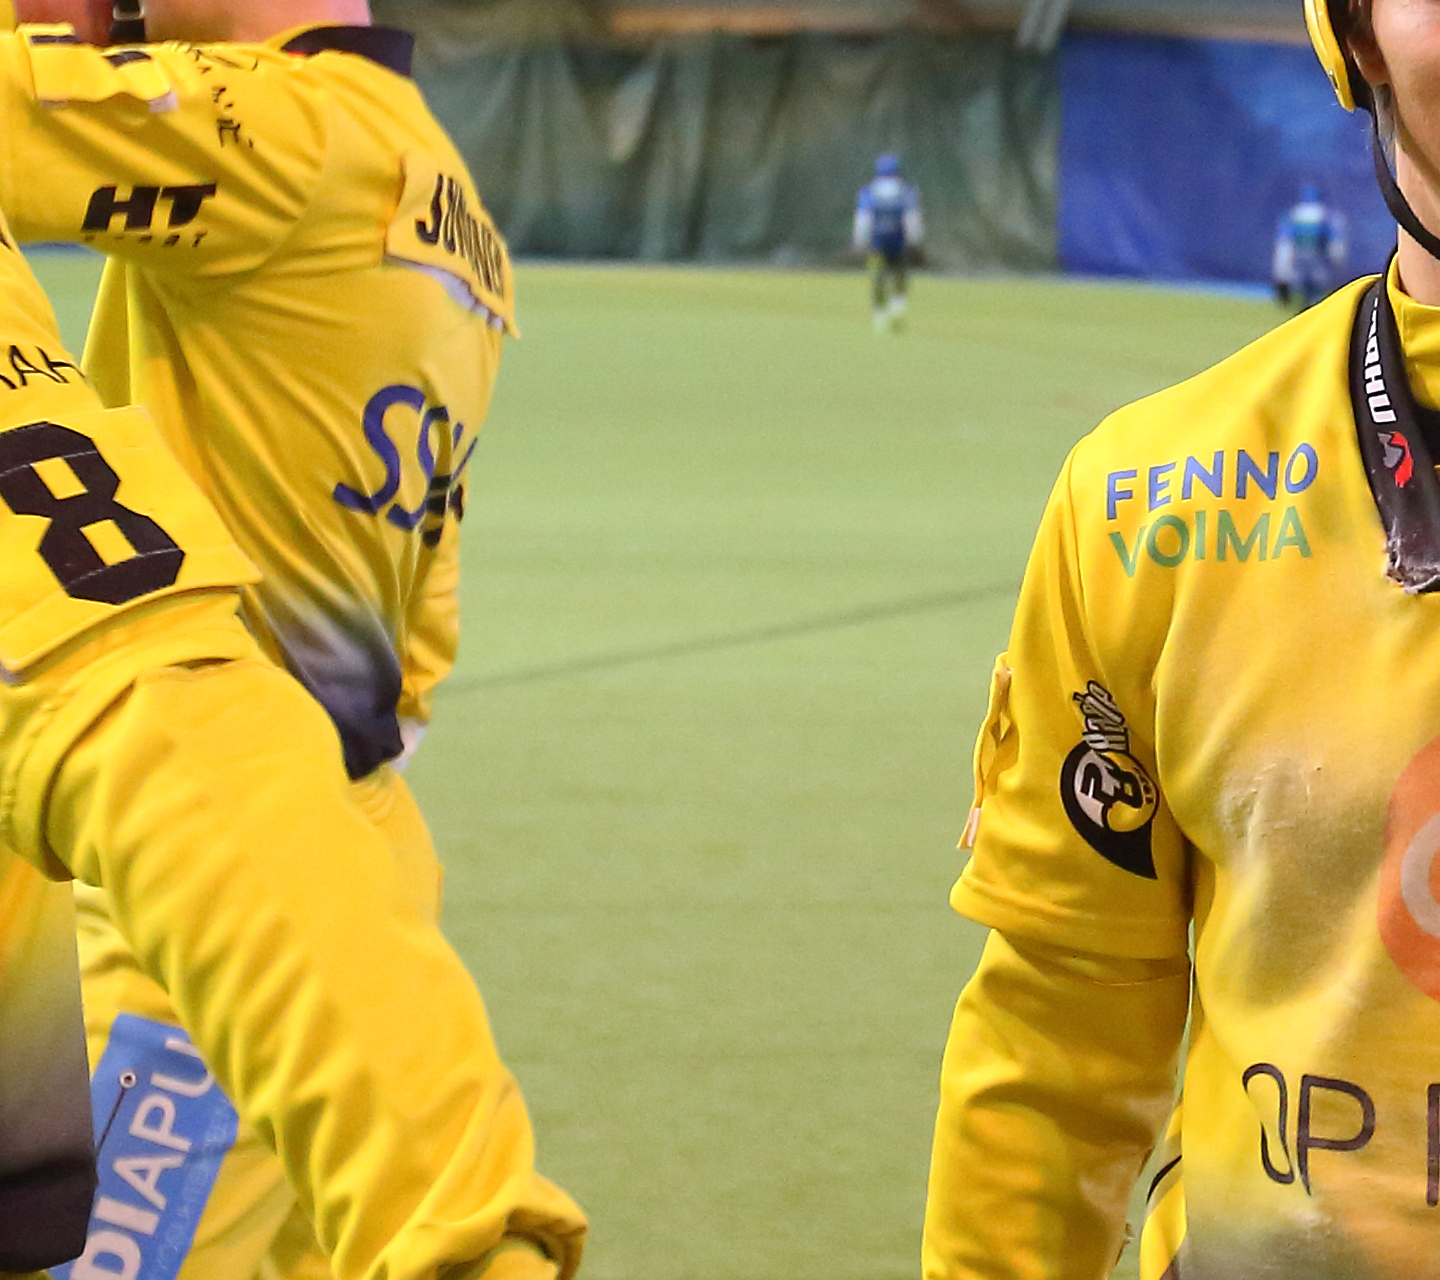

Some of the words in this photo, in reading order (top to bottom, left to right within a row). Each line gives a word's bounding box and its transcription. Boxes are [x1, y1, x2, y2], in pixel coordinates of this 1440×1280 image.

[80, 182, 218, 232] HT
[1106, 442, 1319, 521] FENNO
[1109, 506, 1313, 579] VOIMA
